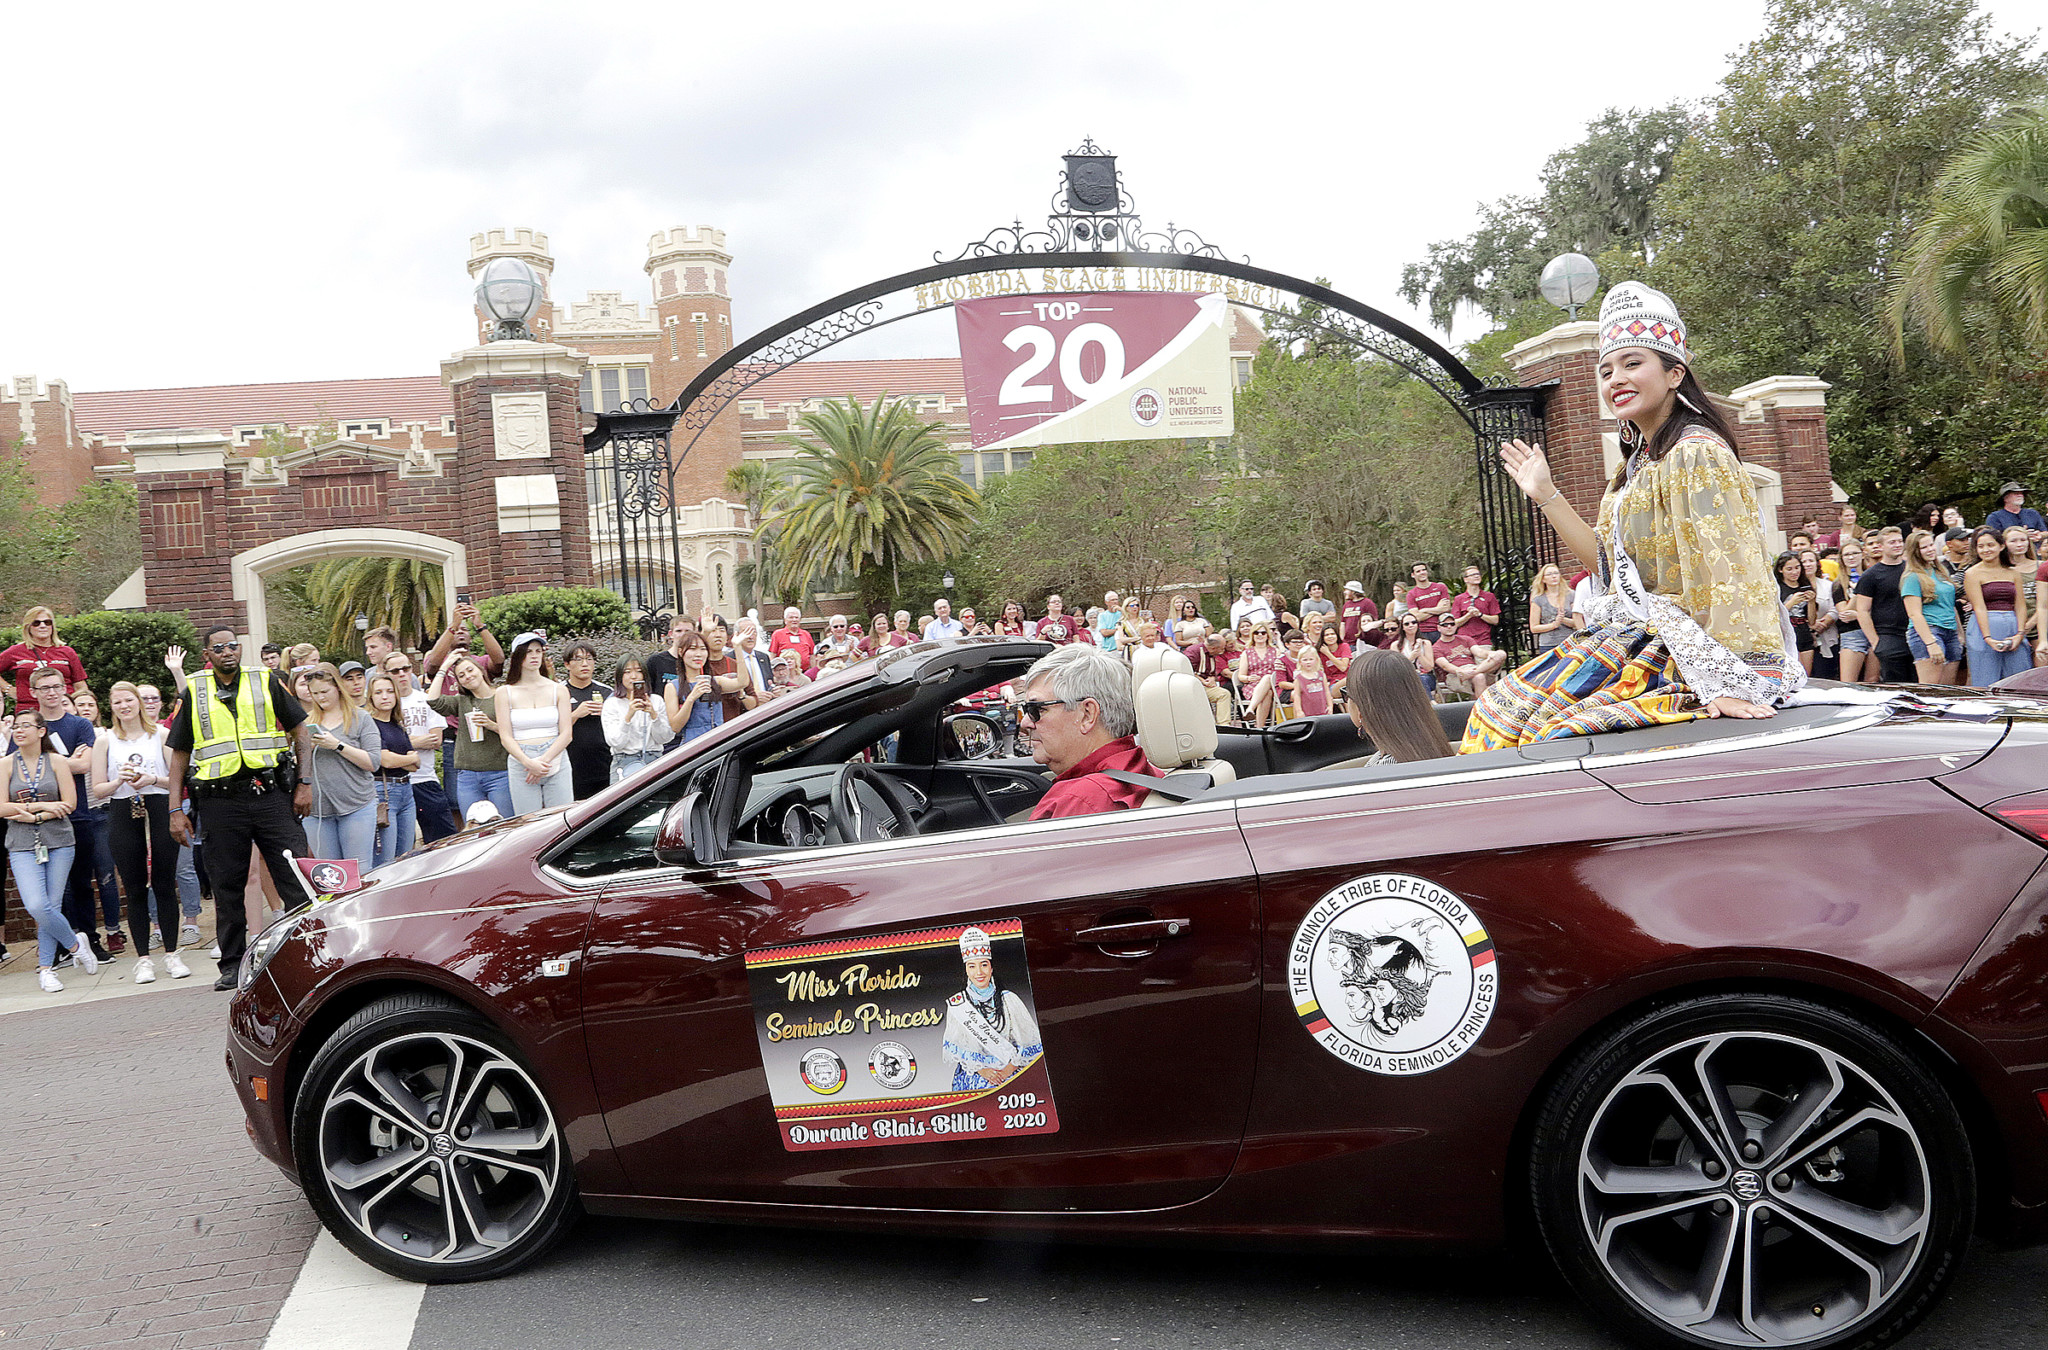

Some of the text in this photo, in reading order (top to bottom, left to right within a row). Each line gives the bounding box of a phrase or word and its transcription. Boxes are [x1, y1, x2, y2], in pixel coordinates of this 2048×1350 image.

[913, 271, 1031, 310] FLORIDA
[1043, 268, 1126, 291] STATE
[1610, 290, 1629, 301] MISS
[1033, 301, 1081, 322] TOP
[998, 322, 1126, 406] 20
[1168, 386, 1208, 395] NATIONAL
[1169, 397, 1198, 405] PUBLIC
[1169, 406, 1223, 415] UNIVERSITIES
[1616, 551, 1641, 605] Florida
[198, 687, 209, 728] POLICE
[410, 707, 427, 715] THE
[1293, 878, 1469, 996] THE SEMINOLE TRIBE OF FLORIDA
[775, 964, 921, 1002] Miss Florida
[766, 1003, 943, 1042] Seminole Princess
[1323, 973, 1494, 1072] FLORIDA SEMINOLE PRINCESS
[997, 1092, 1046, 1110] 2019-
[789, 1112, 987, 1145] Durante Blais-Billie
[1003, 1111, 1047, 1129] 2020
